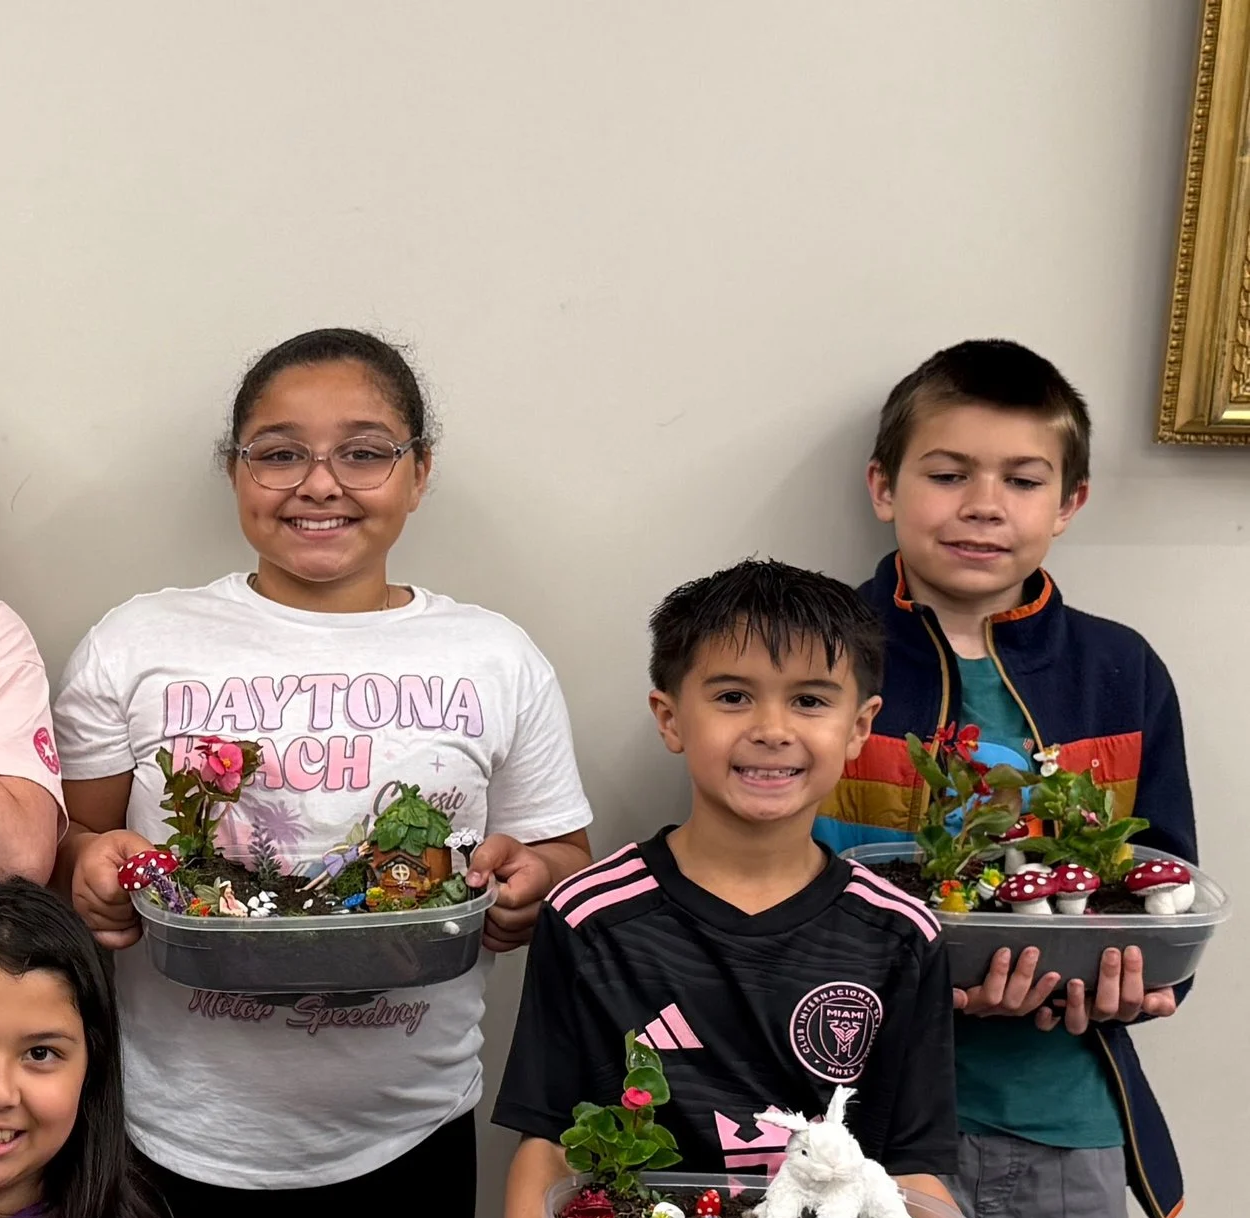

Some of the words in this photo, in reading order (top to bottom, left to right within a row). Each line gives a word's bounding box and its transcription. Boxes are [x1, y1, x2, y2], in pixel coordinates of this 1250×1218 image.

[163, 673, 484, 738] DAYTONA
[172, 735, 373, 791] BACH
[373, 780, 467, 816] Cssic
[188, 989, 275, 1020] Motor
[286, 994, 431, 1037] Speedway
[798, 989, 875, 1024] INTERNACIONAL
[827, 1009, 864, 1019] MIAMI
[796, 1028, 810, 1054] CLUB
[827, 1066, 855, 1076] MMXX
